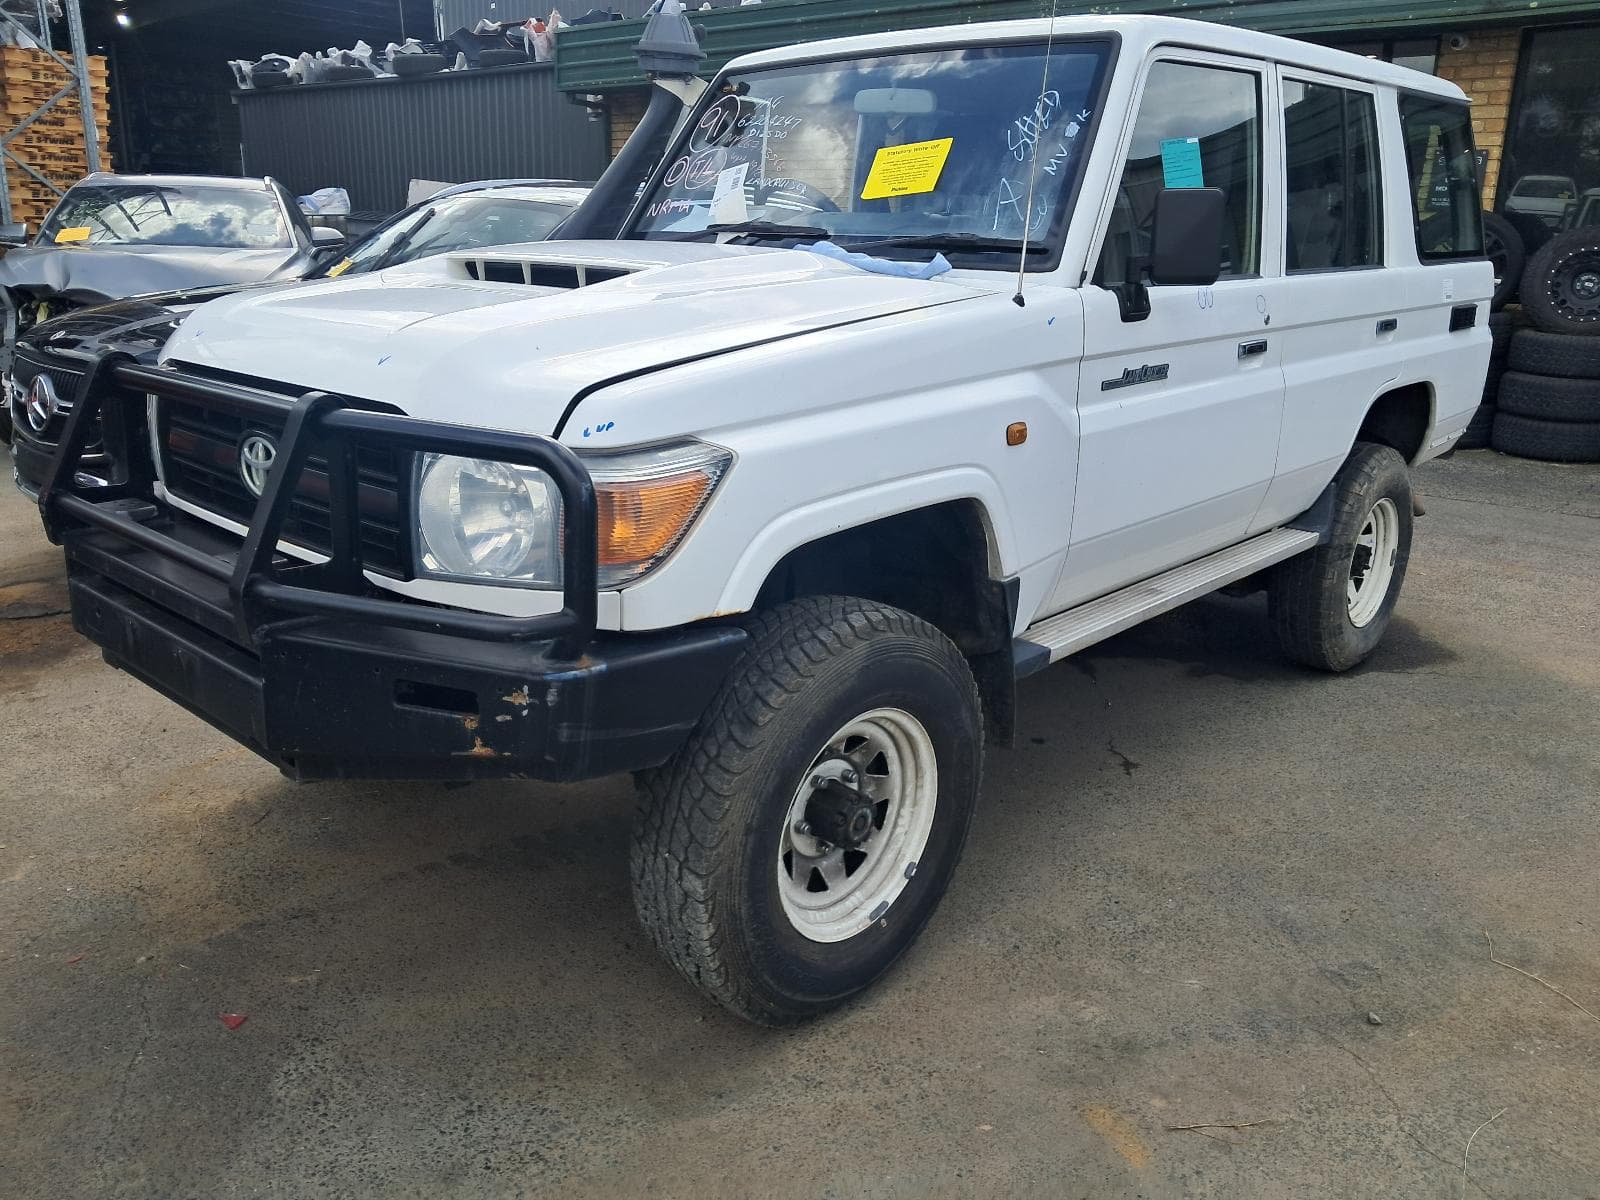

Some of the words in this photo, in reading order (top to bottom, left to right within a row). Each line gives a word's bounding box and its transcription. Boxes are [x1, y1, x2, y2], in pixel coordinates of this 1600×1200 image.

[700, 107, 729, 141] 91
[36, 133, 75, 145] S-TWINS
[596, 421, 615, 433] UP
